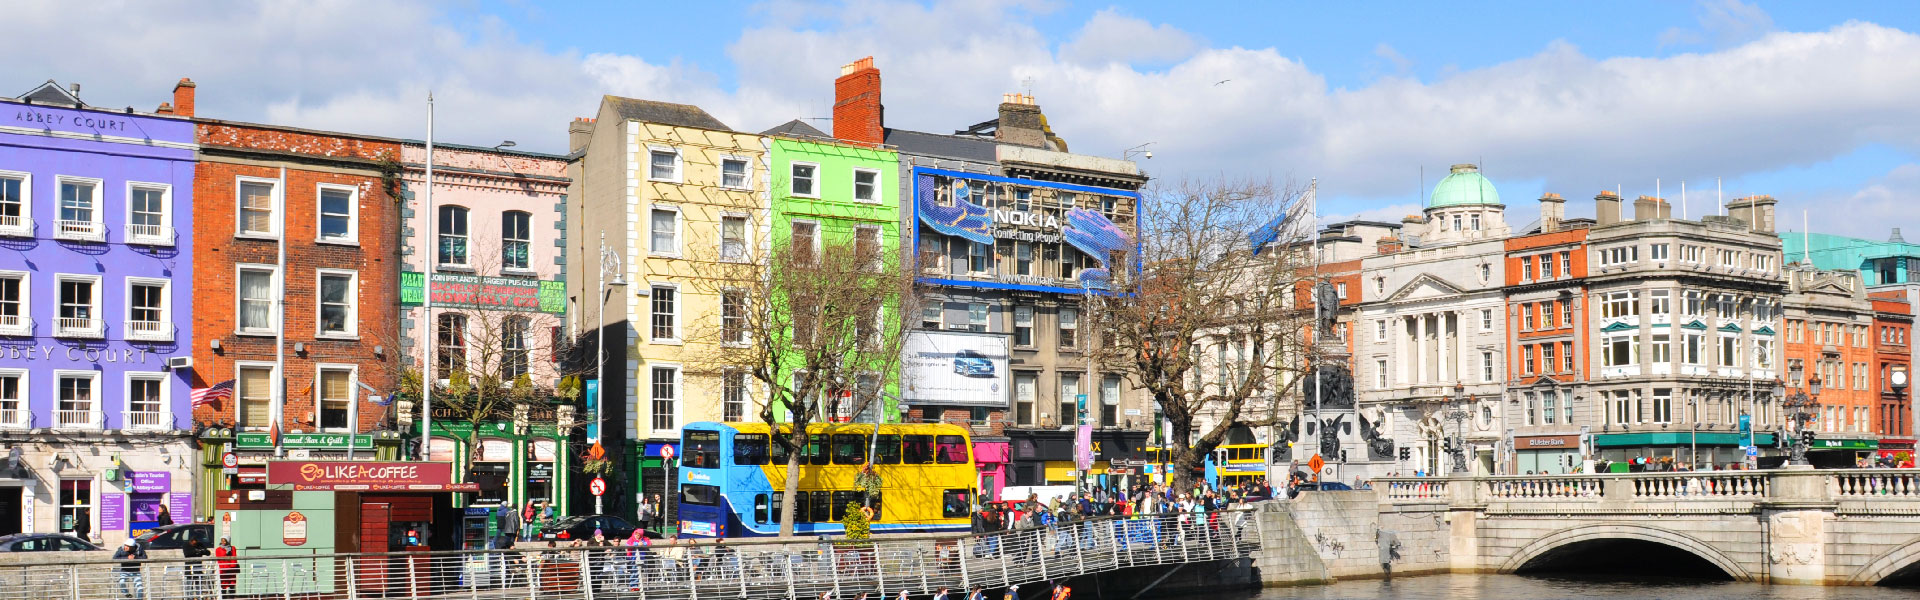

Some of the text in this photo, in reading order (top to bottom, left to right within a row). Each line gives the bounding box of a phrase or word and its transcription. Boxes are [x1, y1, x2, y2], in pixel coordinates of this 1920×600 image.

[16, 112, 125, 131] ABBEY COURT
[994, 209, 1058, 230] NOKIA
[993, 226, 1061, 245] Connecting People
[402, 273, 424, 287] VALU
[431, 292, 467, 303] NOW
[469, 294, 510, 305] ONLY
[66, 347, 147, 364] COURT
[304, 435, 318, 444] Bar
[319, 435, 325, 444] &
[327, 435, 343, 446] Grill
[1751, 446, 1756, 454] P
